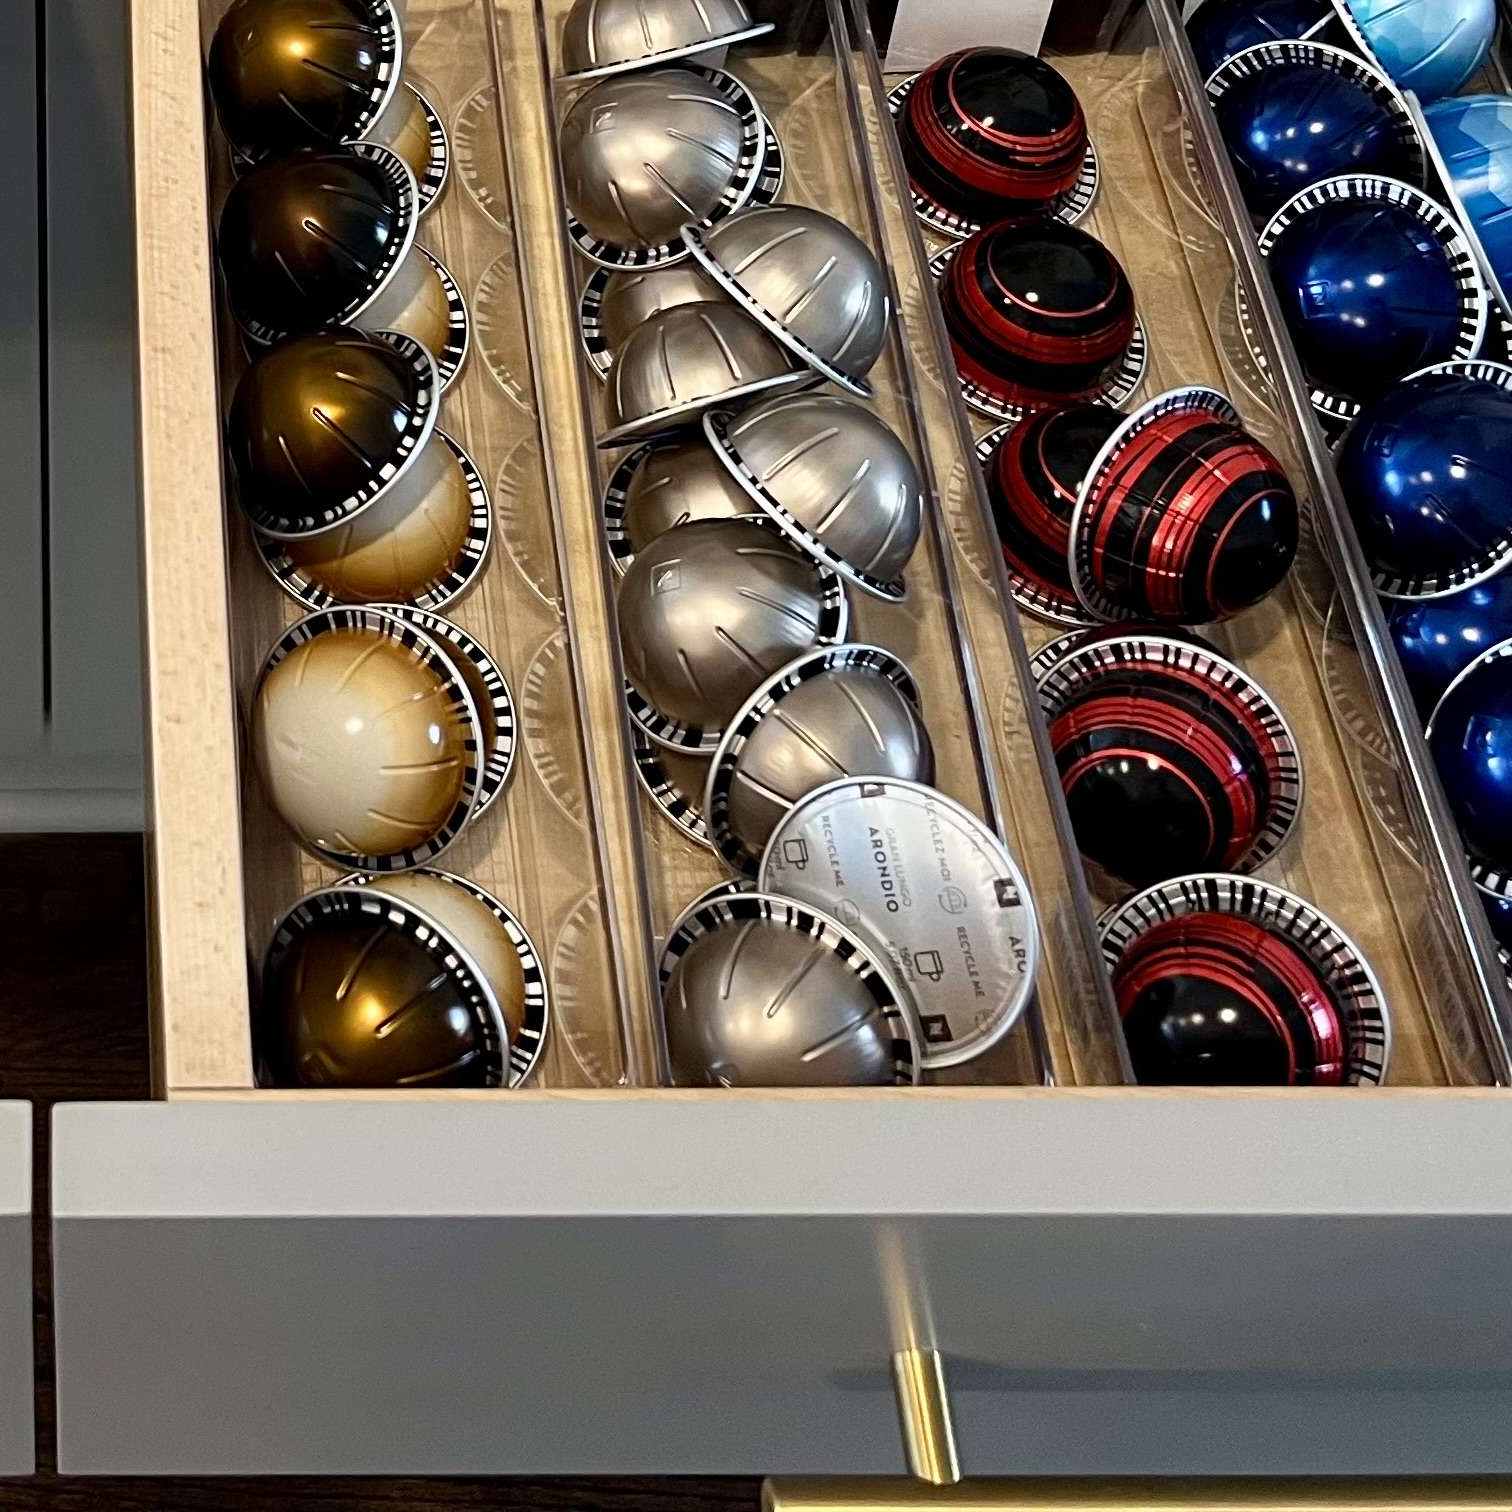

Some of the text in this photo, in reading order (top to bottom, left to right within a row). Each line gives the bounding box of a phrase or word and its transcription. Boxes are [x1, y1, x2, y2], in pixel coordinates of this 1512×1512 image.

[822, 815, 845, 888] RECYCLE ME
[868, 826, 899, 913] ARONDIO
[894, 865, 912, 909] LUNGO
[956, 926, 986, 998] RECYCLE ME
